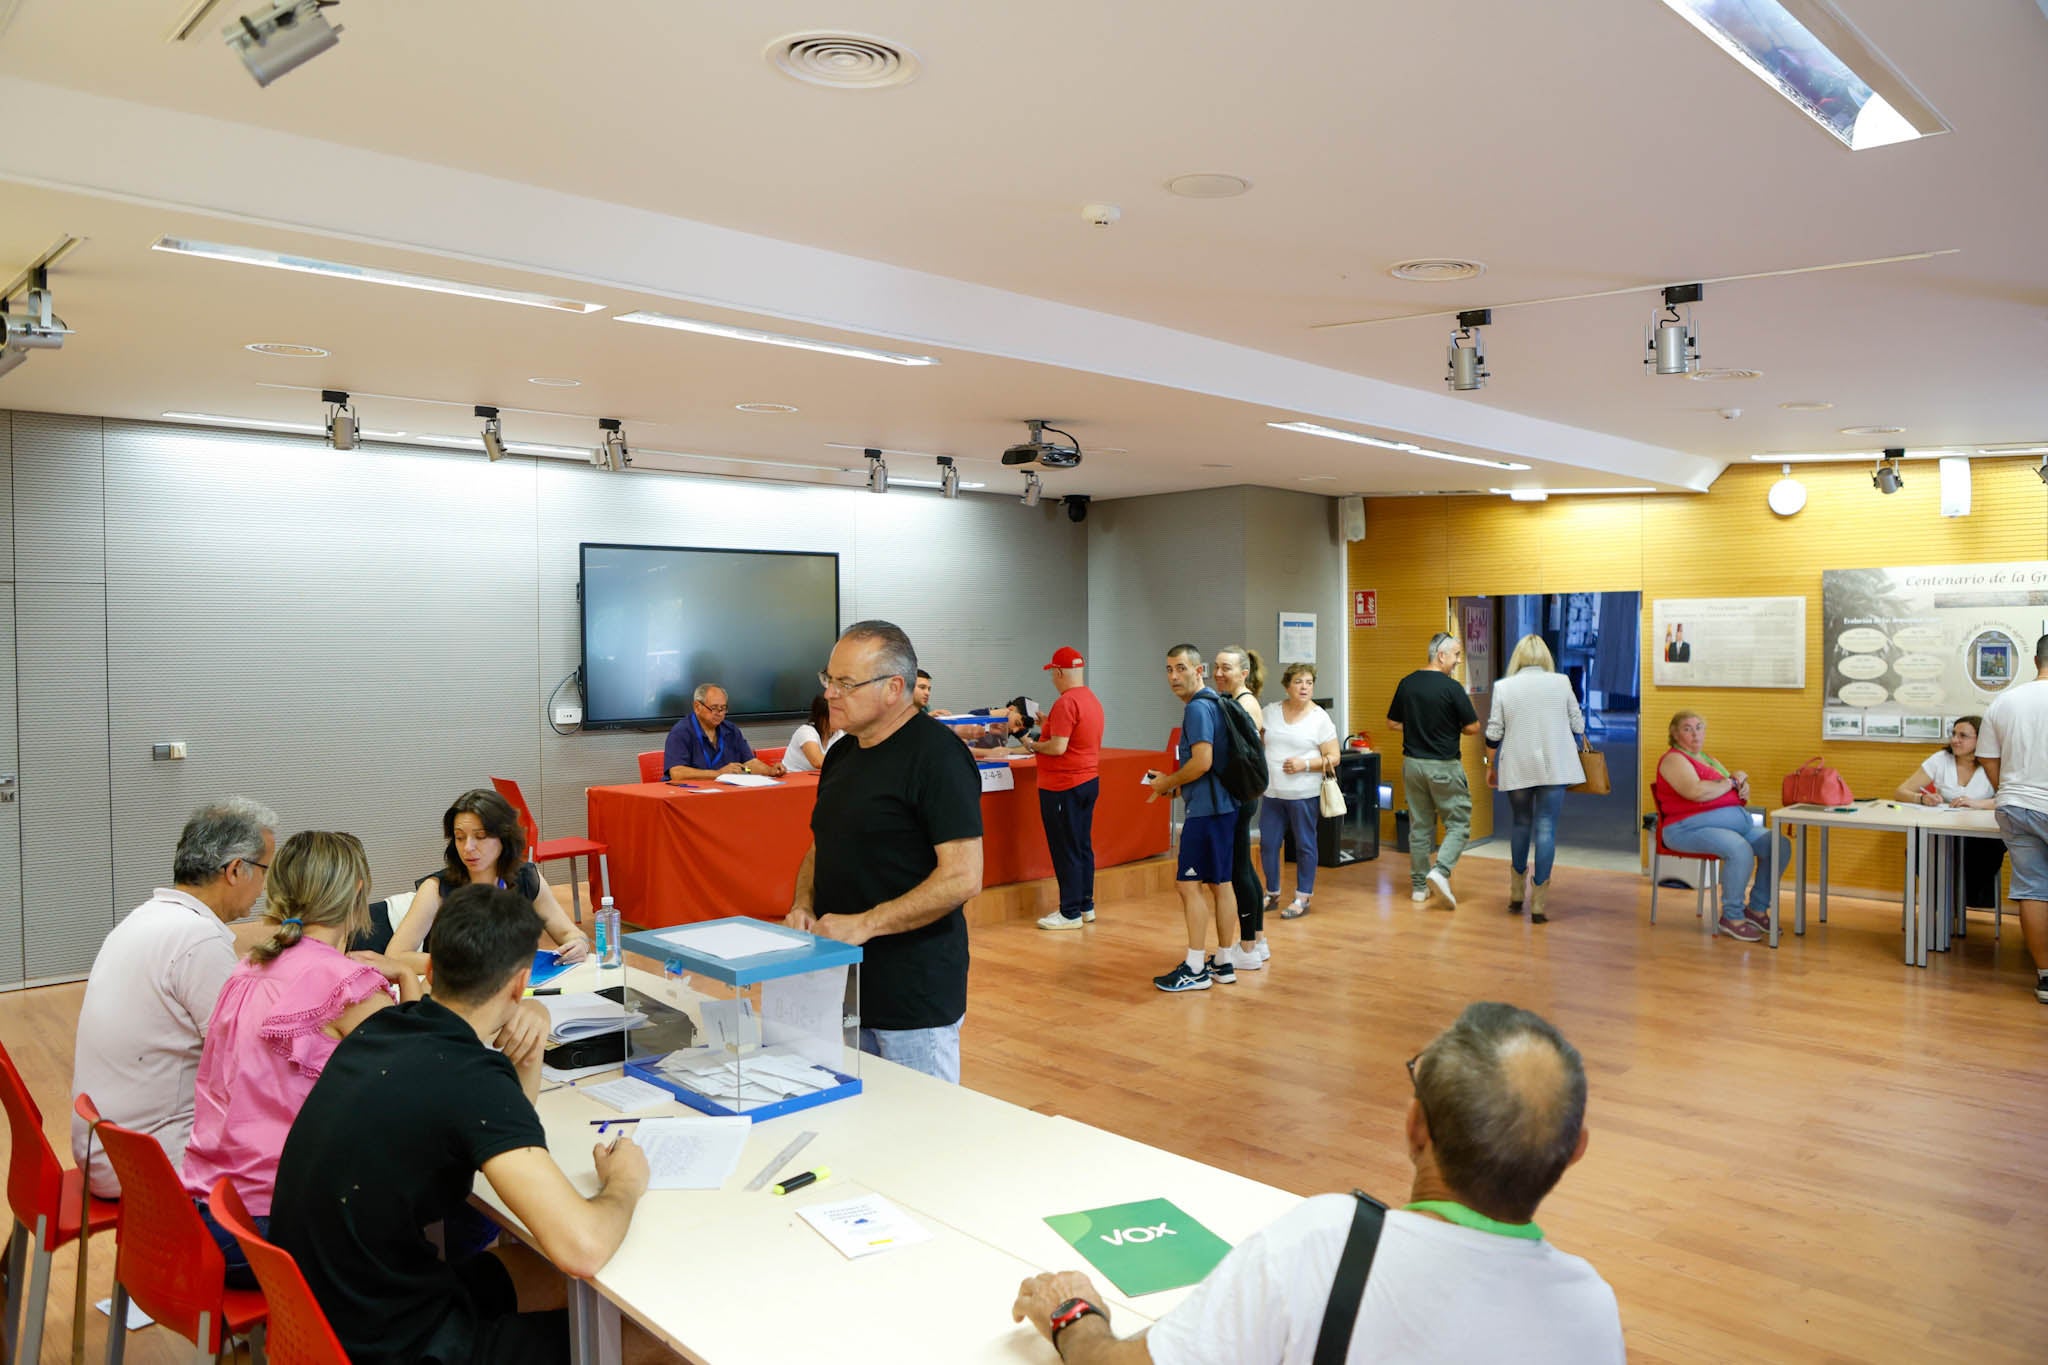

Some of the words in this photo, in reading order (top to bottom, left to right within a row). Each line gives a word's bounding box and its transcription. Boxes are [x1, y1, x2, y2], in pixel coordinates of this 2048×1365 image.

[1906, 575, 1985, 586] Centenario
[1989, 572, 2006, 584] de
[2011, 571, 2025, 583] la
[1100, 1222, 1178, 1246] VOX
